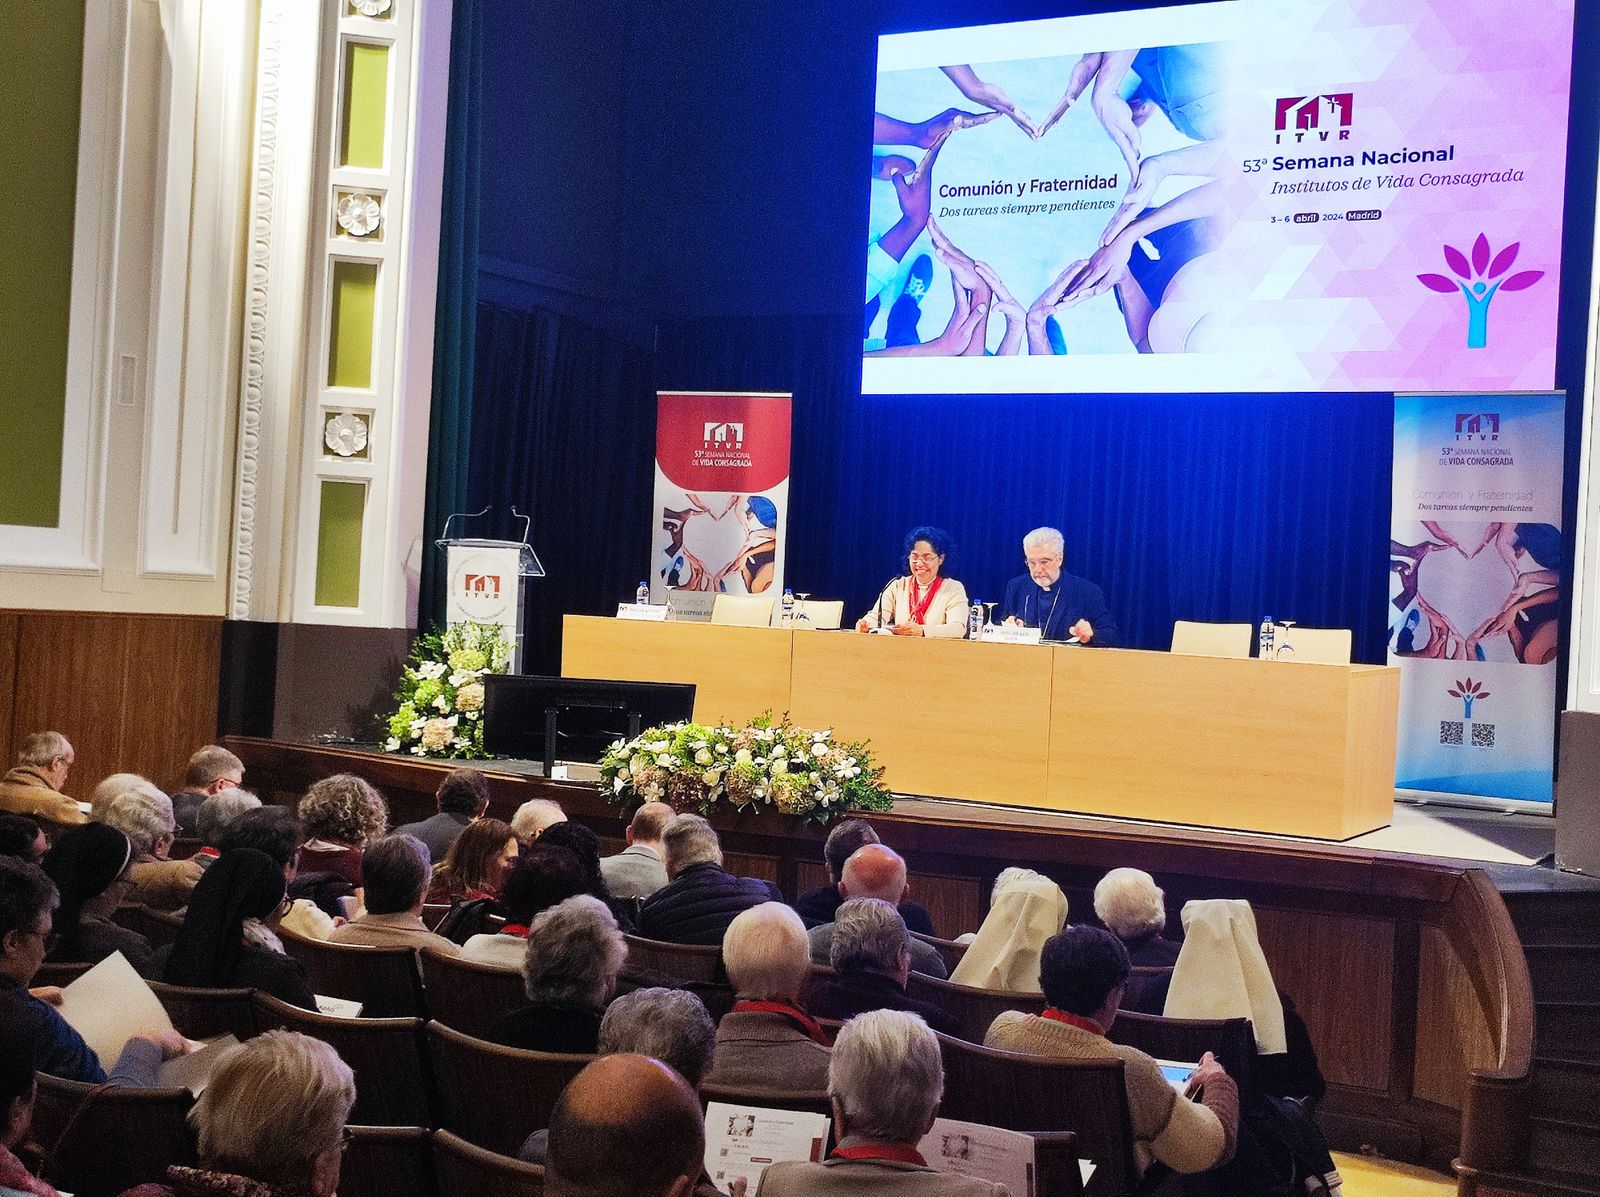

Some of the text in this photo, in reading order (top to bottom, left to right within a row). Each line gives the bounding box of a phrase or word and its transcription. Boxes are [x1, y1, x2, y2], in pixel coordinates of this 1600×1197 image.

[1275, 129, 1351, 145] ITVR
[1272, 153, 1355, 171] Semana
[1361, 145, 1455, 166] Nacional
[938, 174, 1118, 198] Comunión y Fraternidad
[1270, 168, 1525, 195] Institutos de Vida Consagrada
[939, 200, 1116, 218] Dos tareas siempre pendientes
[1295, 213, 1317, 223] abril
[1322, 213, 1344, 221] 2024
[1347, 210, 1380, 221] Madrid
[704, 442, 742, 450] ITVR
[1480, 448, 1511, 456] NACIONAL
[1449, 457, 1465, 466] VIDA
[1466, 457, 1514, 466] CONSAGRADA
[1477, 489, 1533, 501] Fraternidad
[1418, 502, 1534, 513] Dos tareas siempre pendientes
